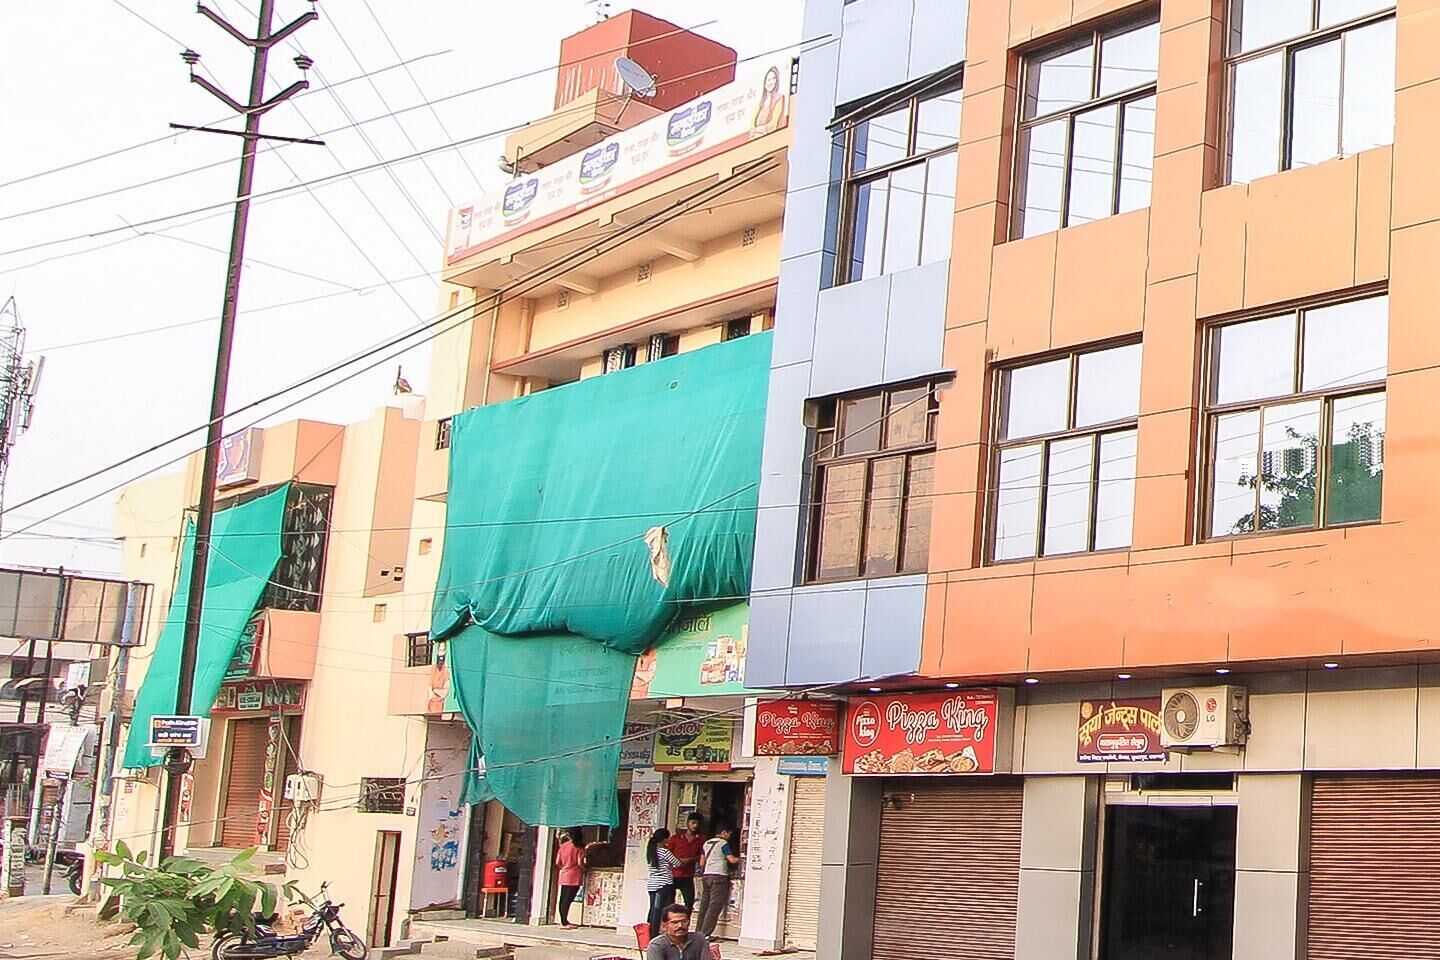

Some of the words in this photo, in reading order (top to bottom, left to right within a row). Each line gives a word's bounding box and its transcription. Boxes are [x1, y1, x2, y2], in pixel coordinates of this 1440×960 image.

[759, 711, 801, 735] Pizza
[801, 711, 835, 734] King
[886, 700, 939, 744] Pizza
[941, 696, 989, 742] King
[1206, 714, 1216, 723] LG
